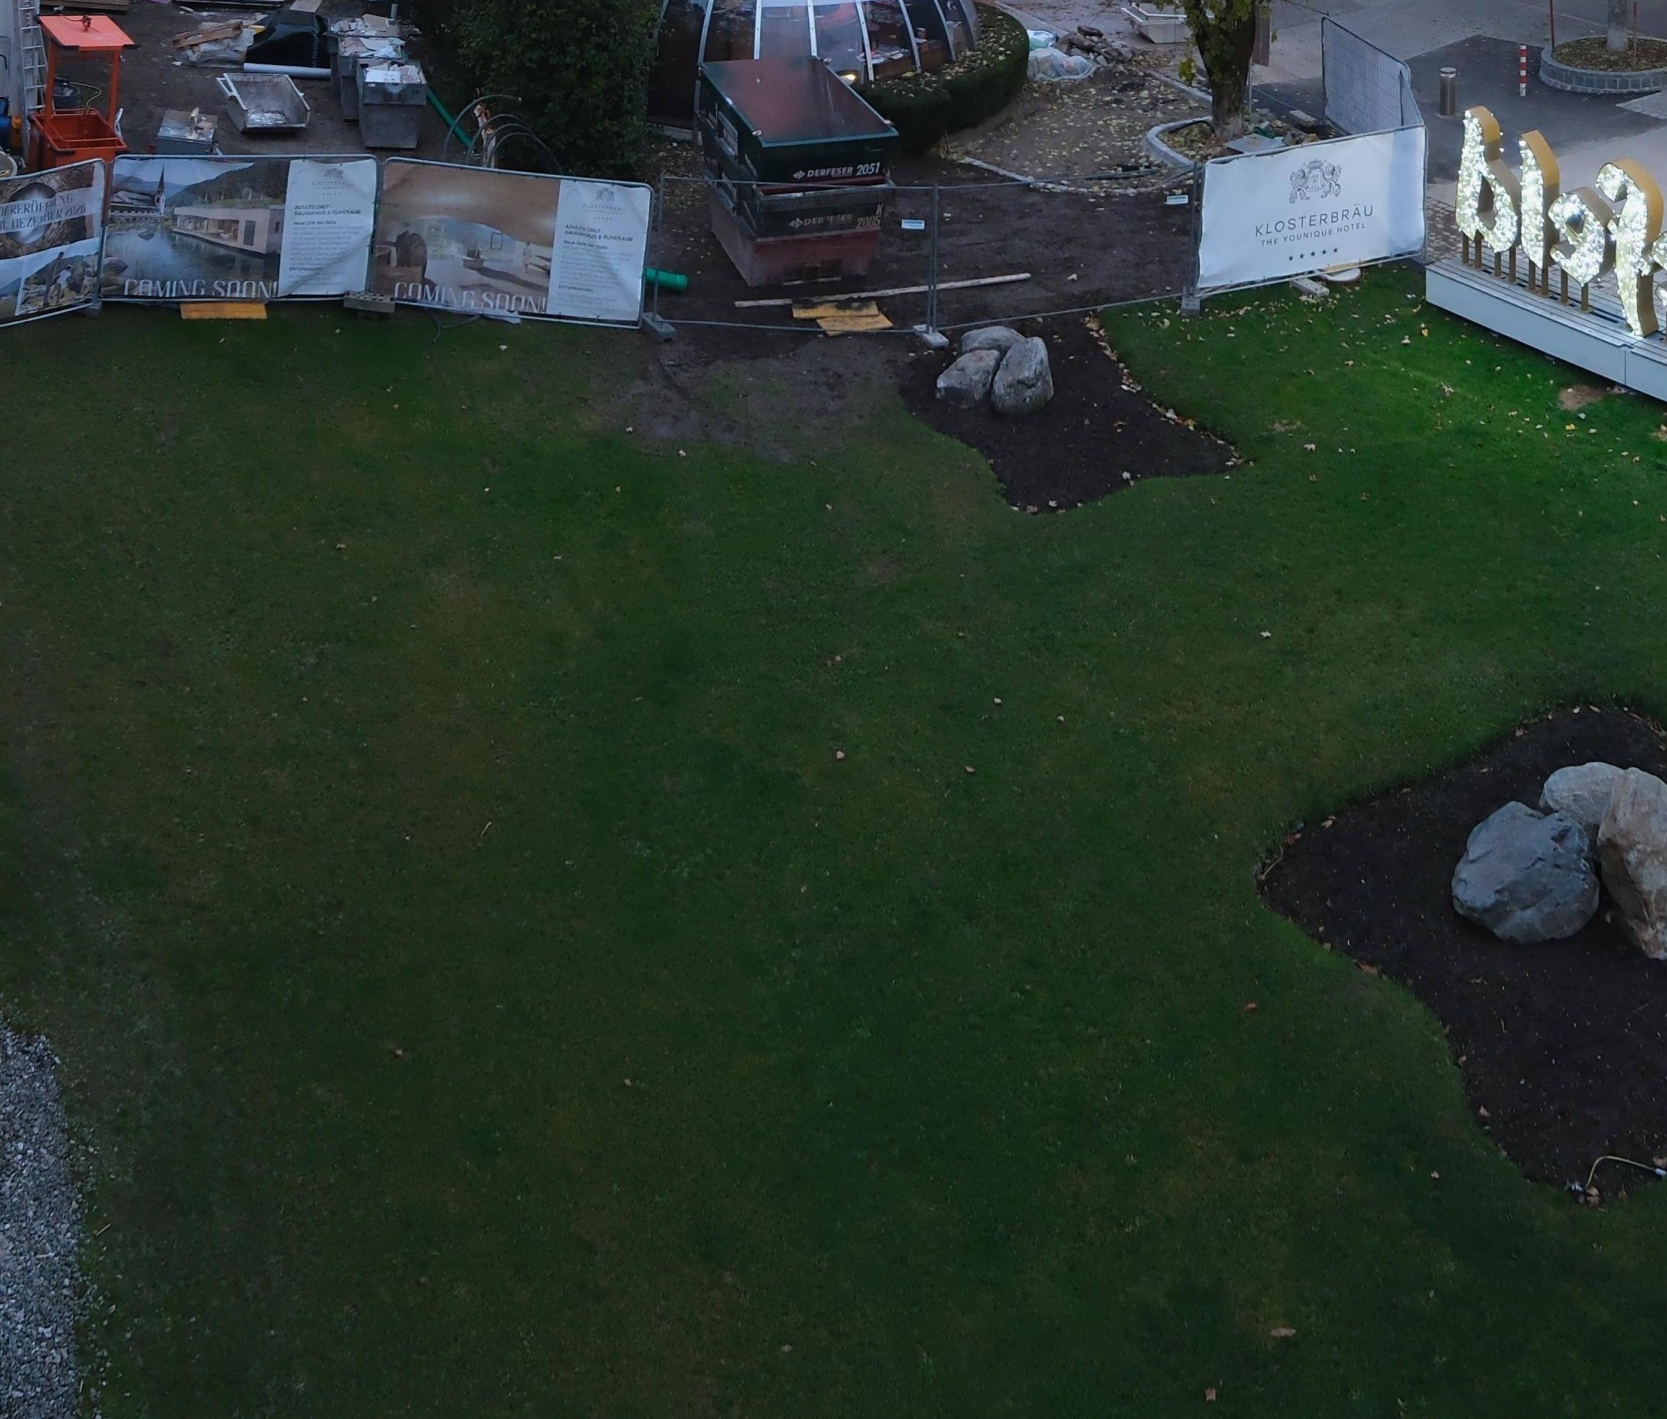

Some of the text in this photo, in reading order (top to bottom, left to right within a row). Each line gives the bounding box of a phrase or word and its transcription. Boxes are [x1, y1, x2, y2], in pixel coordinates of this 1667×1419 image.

[807, 162, 881, 178] DERFESER 2051
[1255, 203, 1375, 237] KLOSTERBRÄU
[1261, 222, 1366, 247] THE YOUNIQUE HOTEL
[124, 279, 279, 298] COMING SOON!
[394, 282, 475, 310] COMING
[481, 290, 548, 314] SOON!
